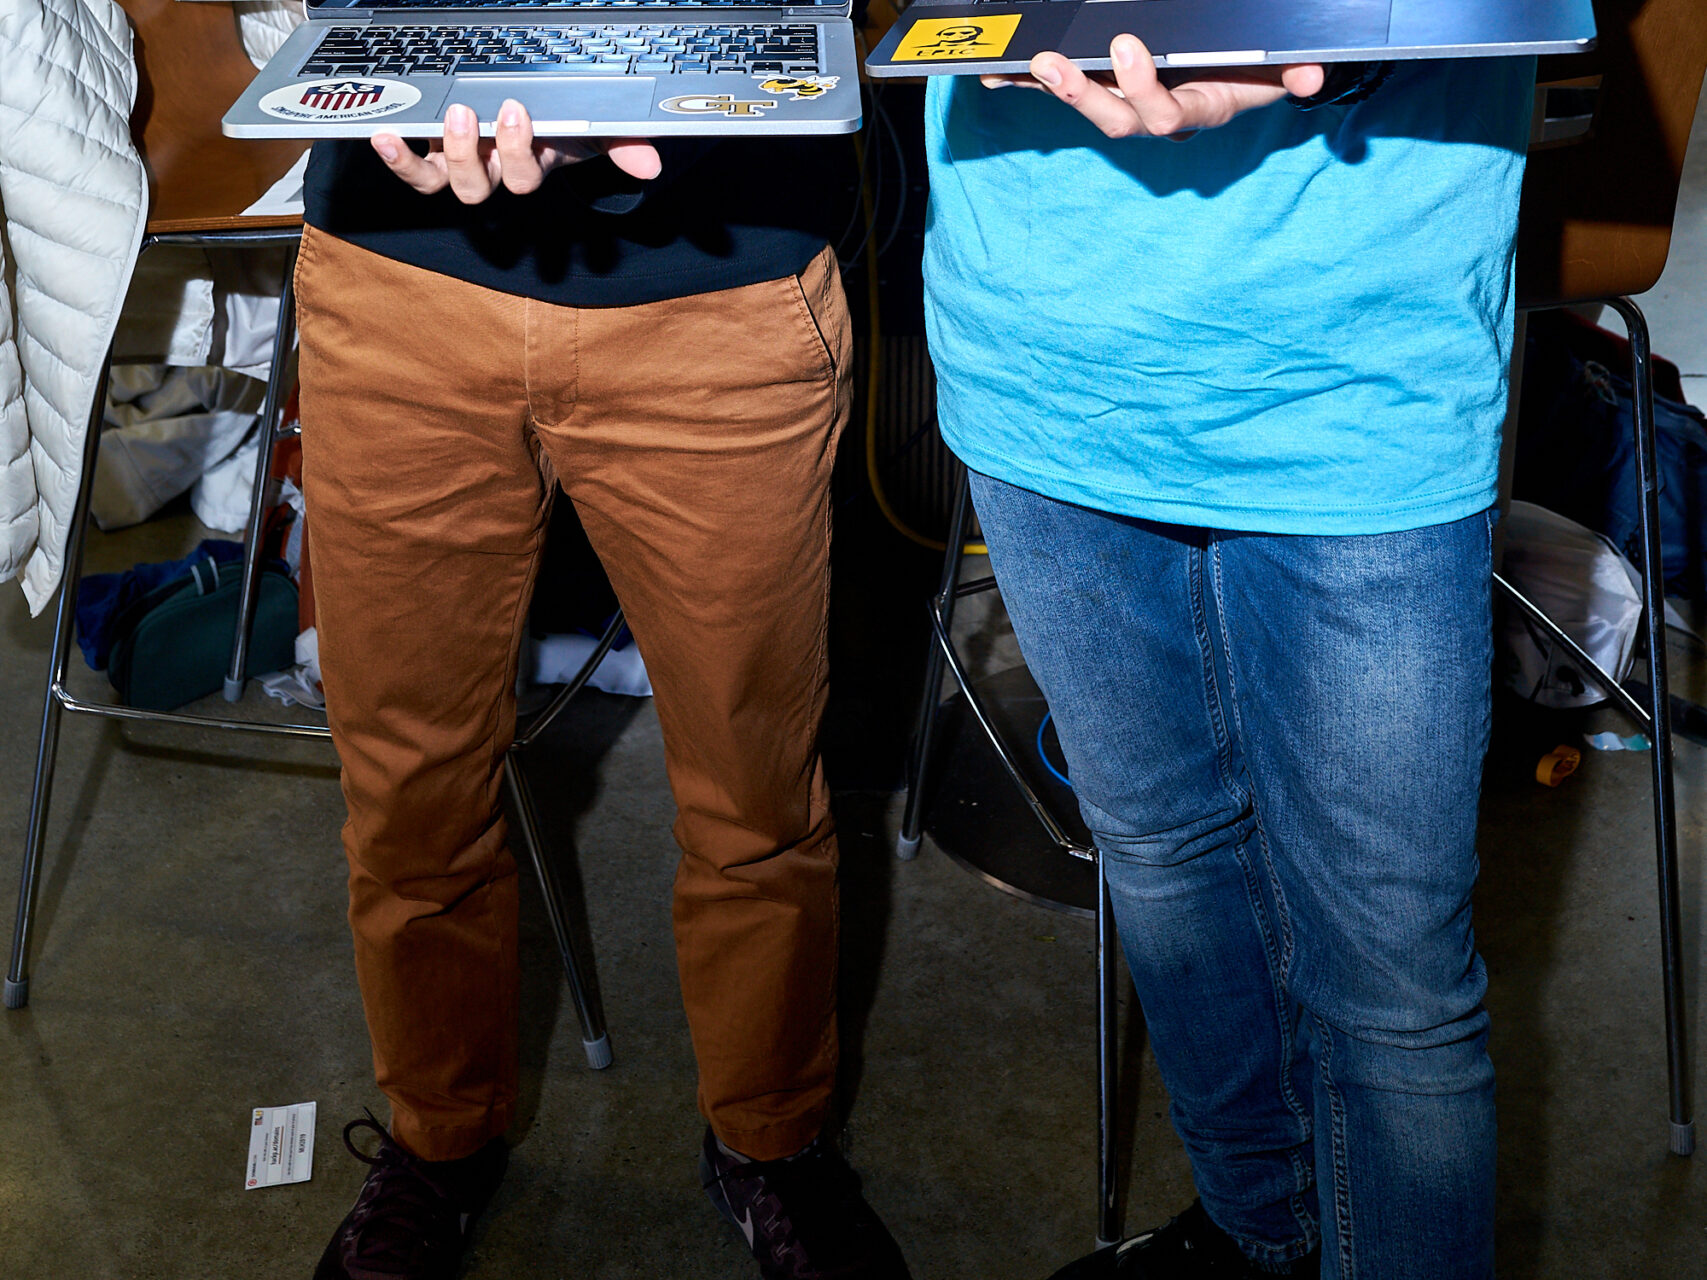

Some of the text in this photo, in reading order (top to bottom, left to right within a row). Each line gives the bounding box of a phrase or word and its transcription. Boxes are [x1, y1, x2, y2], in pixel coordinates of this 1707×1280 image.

[916, 47, 976, 56] EPIC
[318, 81, 375, 94] SAS
[316, 111, 373, 120] AMERICAN
